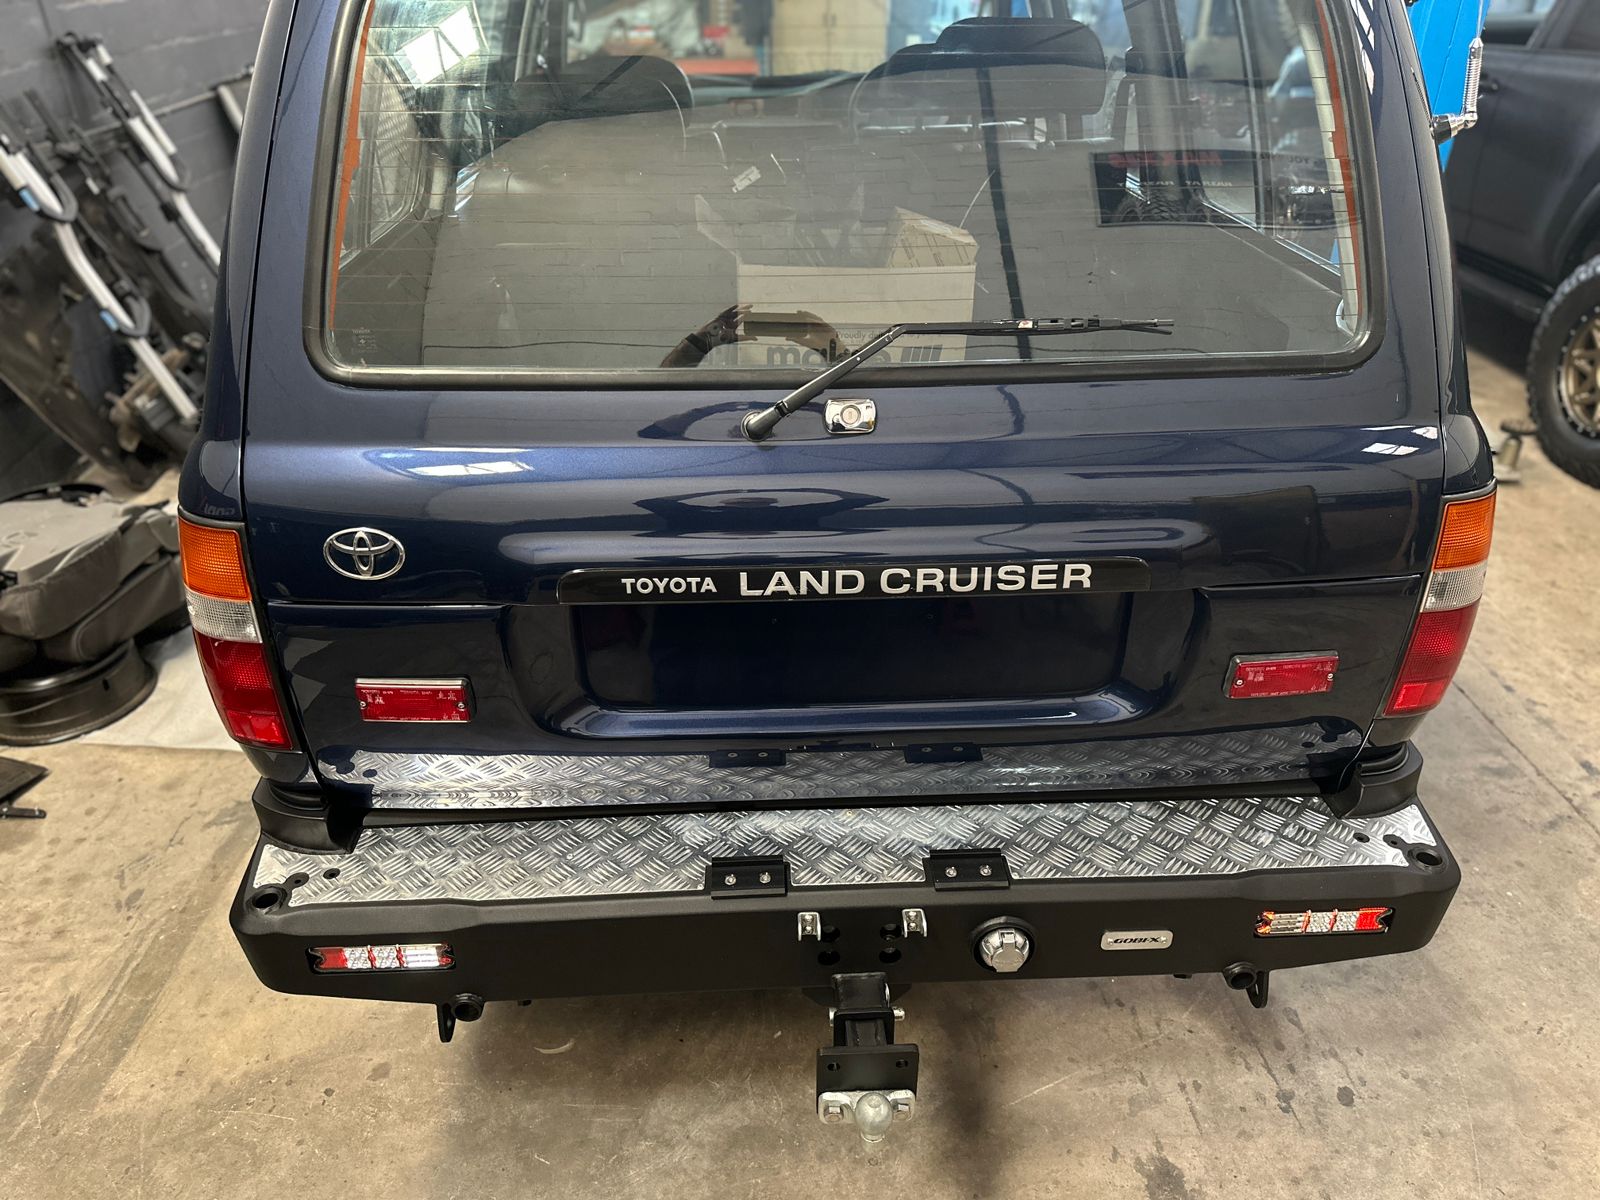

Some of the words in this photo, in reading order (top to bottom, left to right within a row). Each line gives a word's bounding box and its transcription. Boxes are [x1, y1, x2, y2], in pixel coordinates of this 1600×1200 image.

[621, 577, 717, 594] TOYOTA
[739, 570, 865, 596] LAND
[880, 563, 1092, 594] CRUISER
